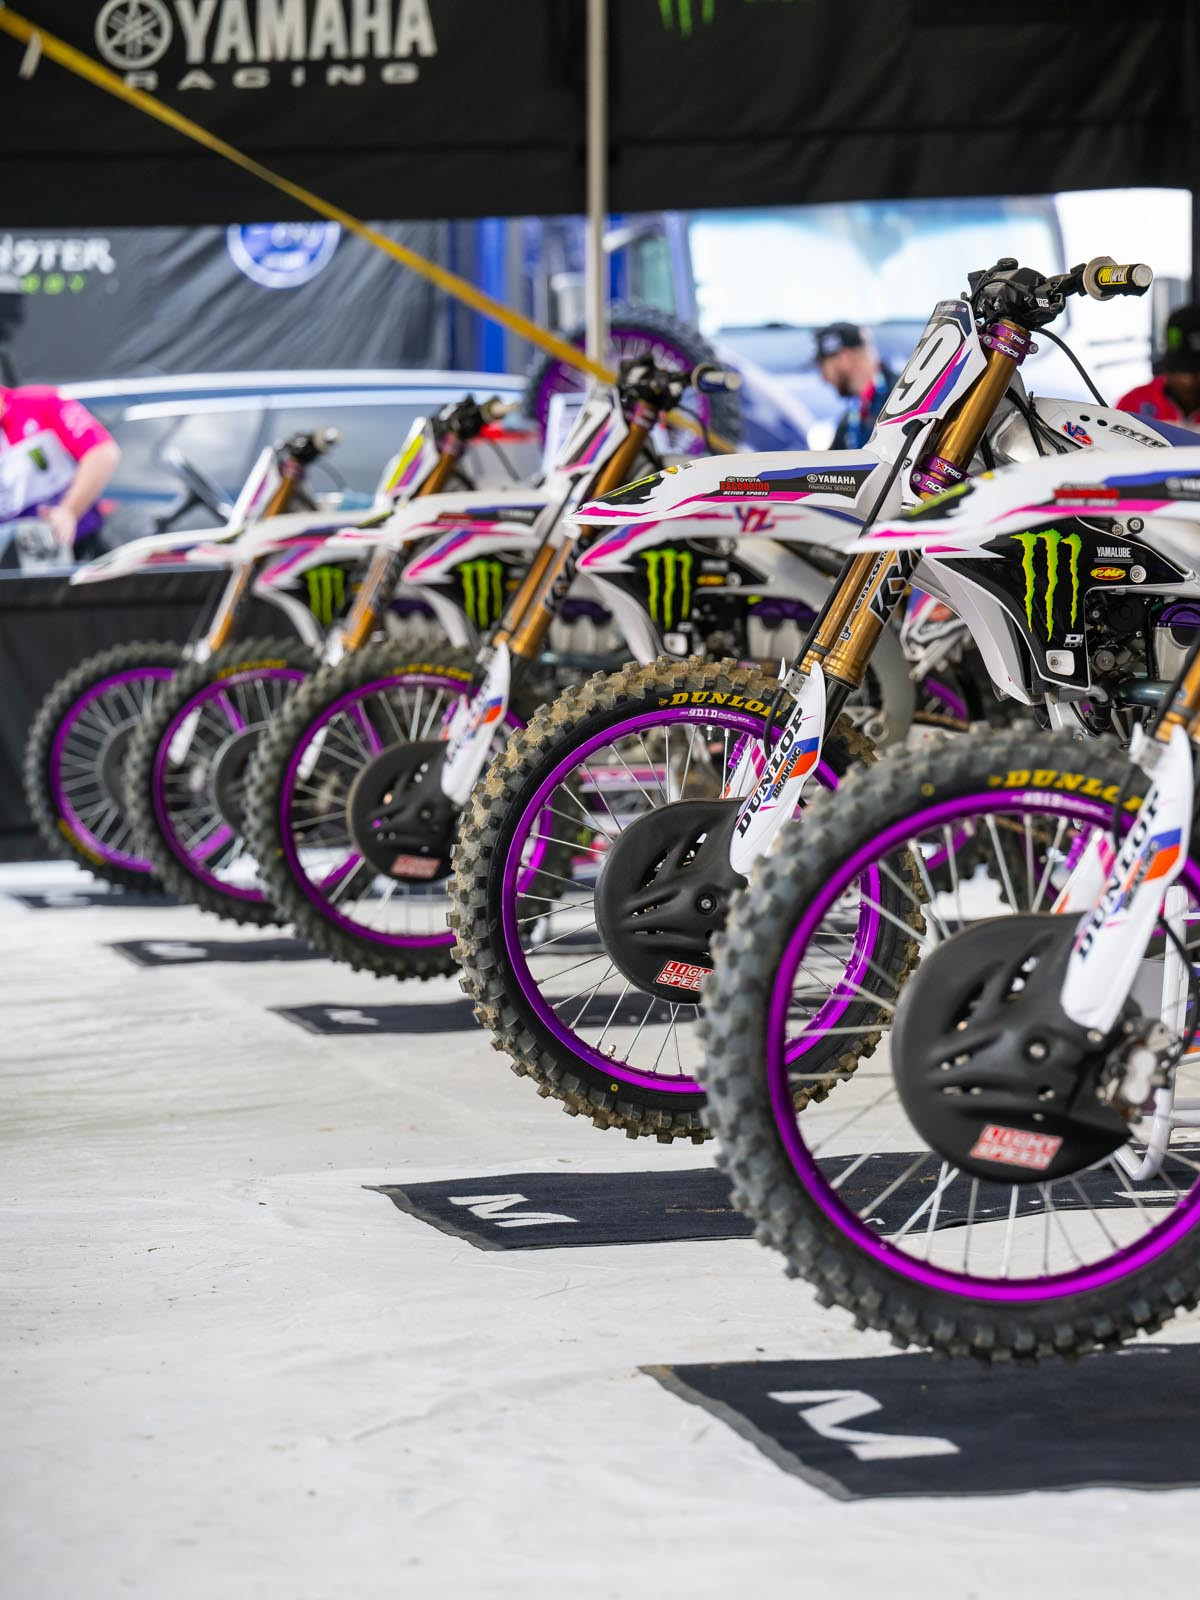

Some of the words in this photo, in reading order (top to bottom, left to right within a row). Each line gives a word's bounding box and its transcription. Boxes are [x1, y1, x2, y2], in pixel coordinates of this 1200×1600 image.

[174, 0, 437, 63] YAMAHA
[125, 62, 420, 91] RACING
[885, 322, 962, 415] 9
[817, 474, 856, 485] YAMAHA
[925, 481, 949, 495] ROC
[1096, 546, 1132, 558] YAMALUBE
[668, 690, 782, 718] DUNLOP
[736, 707, 804, 838] DUNLOP
[771, 746, 803, 801] BRAKING
[659, 972, 702, 989] SPEE
[665, 962, 713, 977] LIGH
